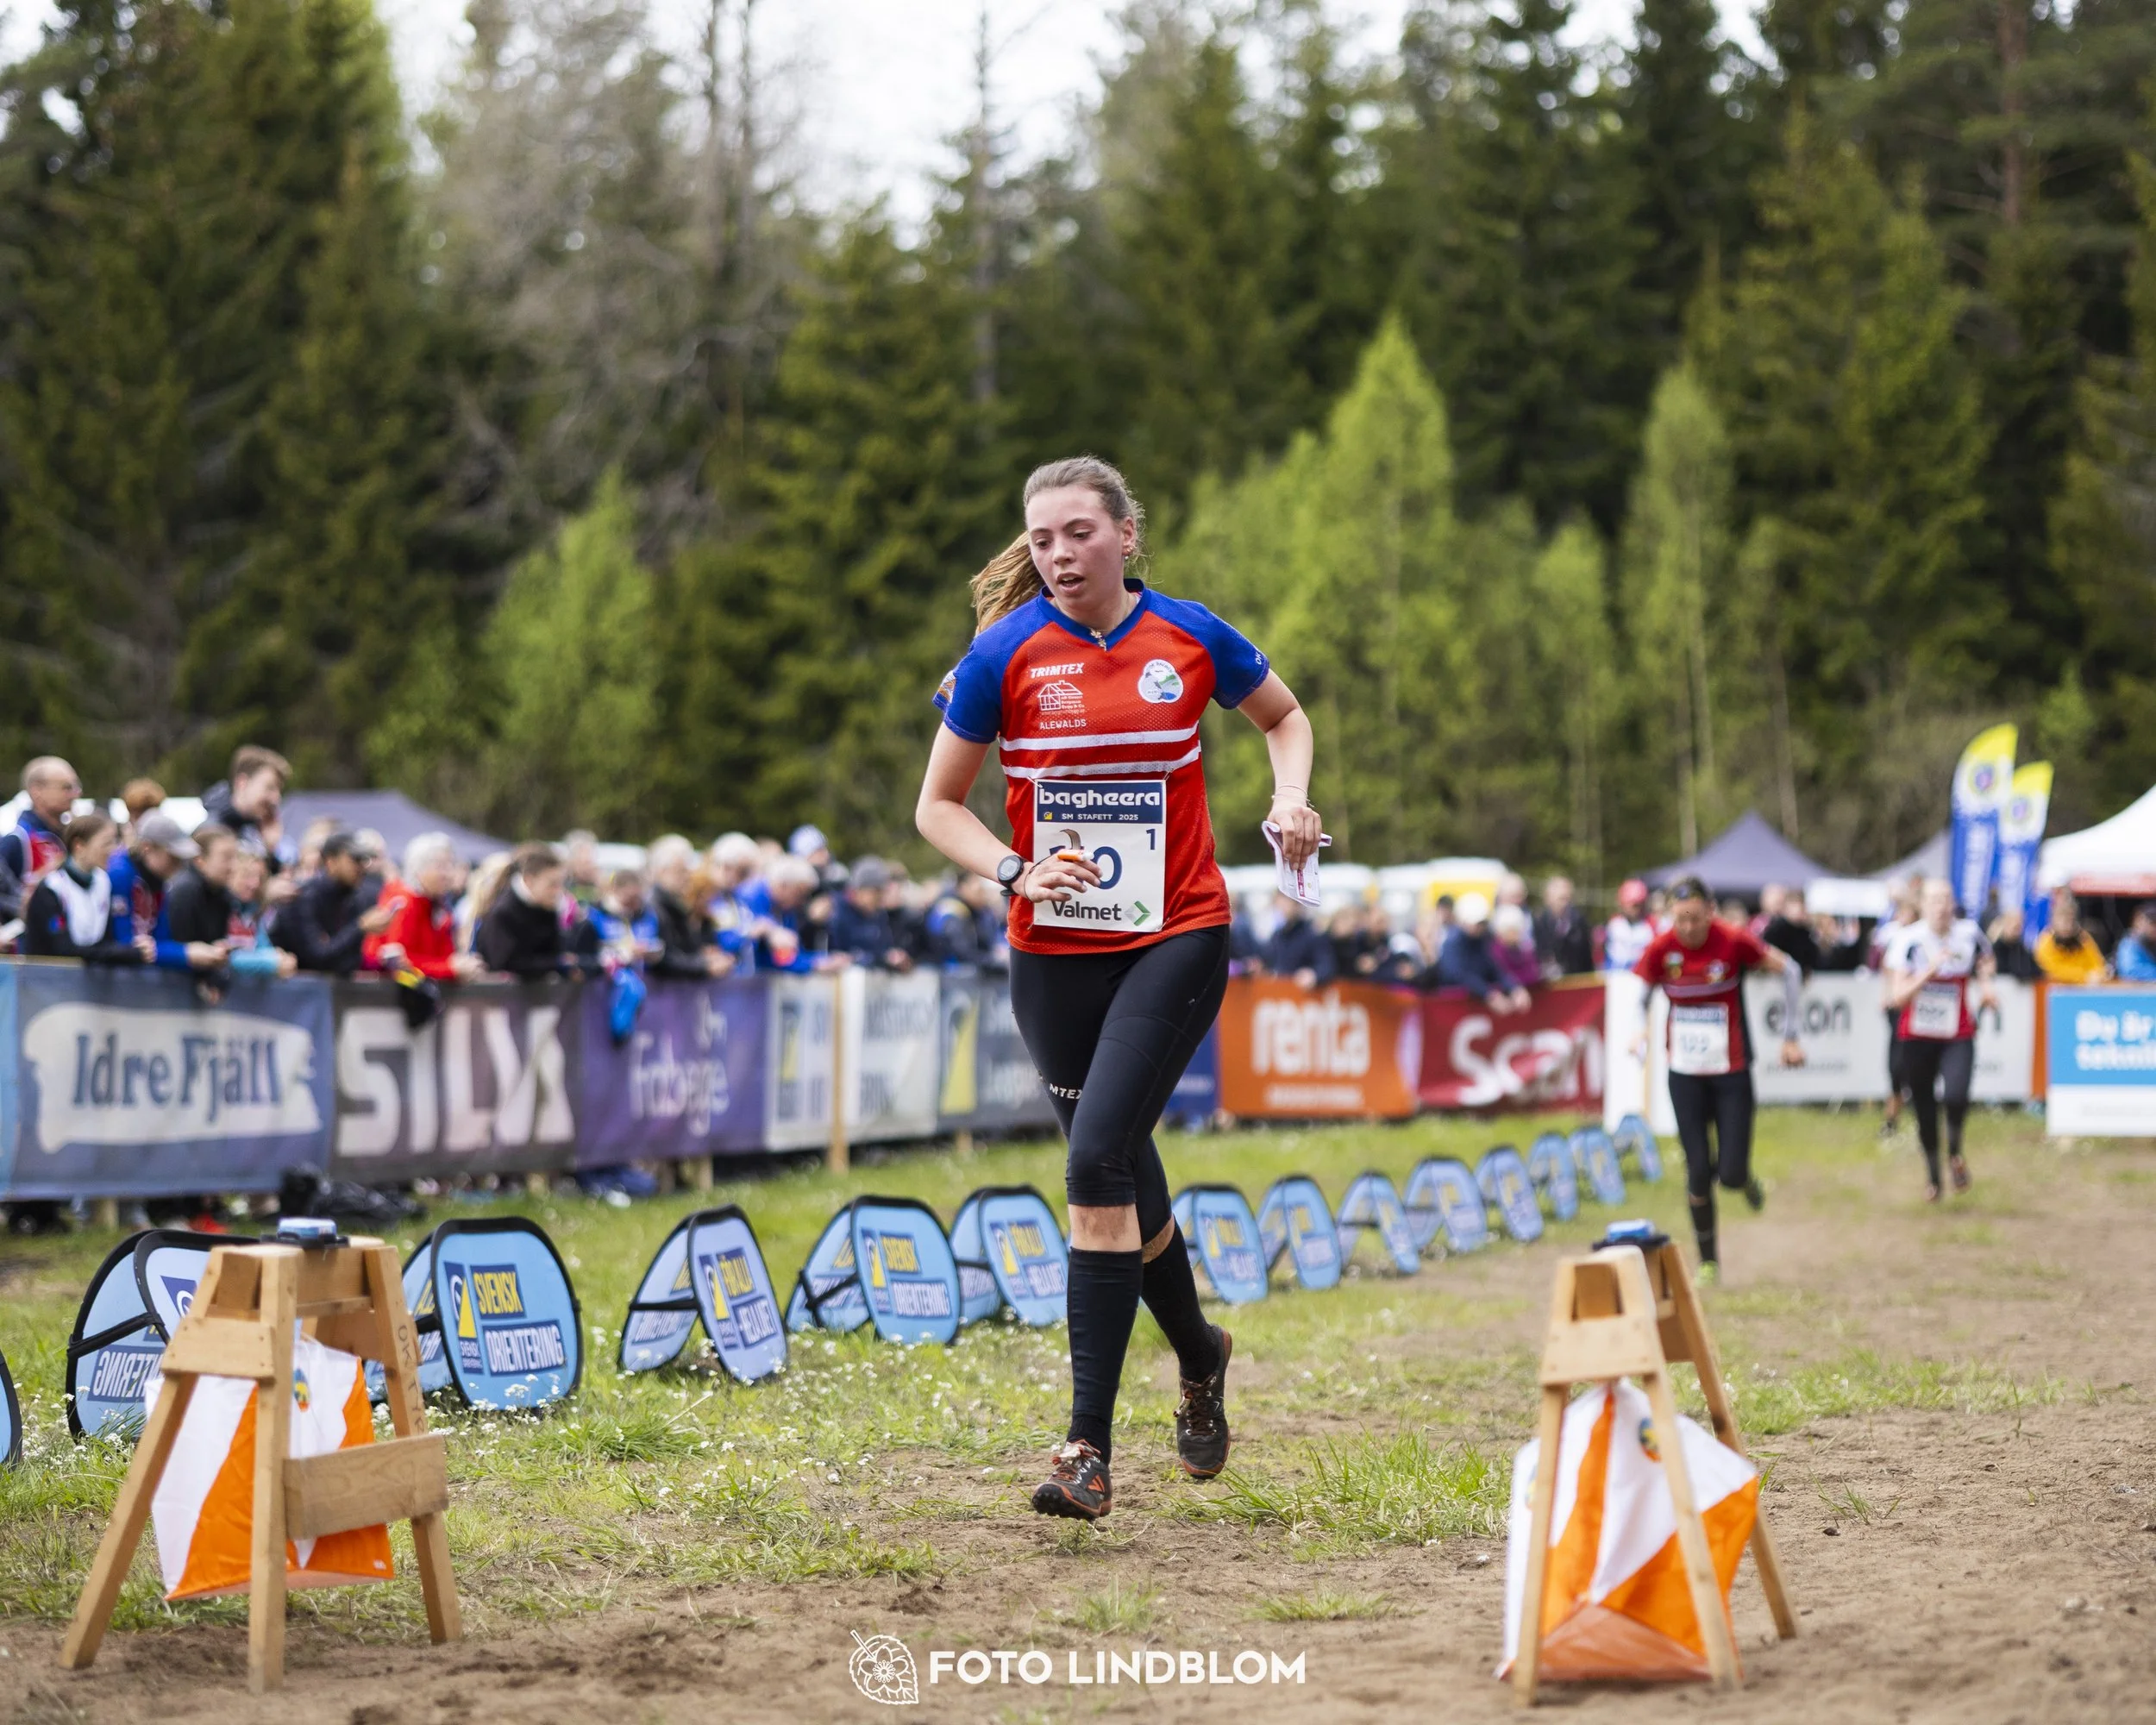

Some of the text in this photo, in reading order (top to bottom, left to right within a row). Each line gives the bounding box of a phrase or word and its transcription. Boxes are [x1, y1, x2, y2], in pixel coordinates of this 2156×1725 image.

[1031, 662, 1084, 679] TRIMTEX
[1039, 718, 1087, 730] ALEWALDS
[1039, 788, 1161, 809] bagheera
[1146, 828, 1156, 850] 1
[1051, 900, 1122, 921] Valmet
[1250, 994, 1371, 1077] renta
[72, 1032, 282, 1124] Idre Fjäll
[473, 1270, 523, 1314] SVENSK
[484, 1324, 565, 1373] ORIENTERING
